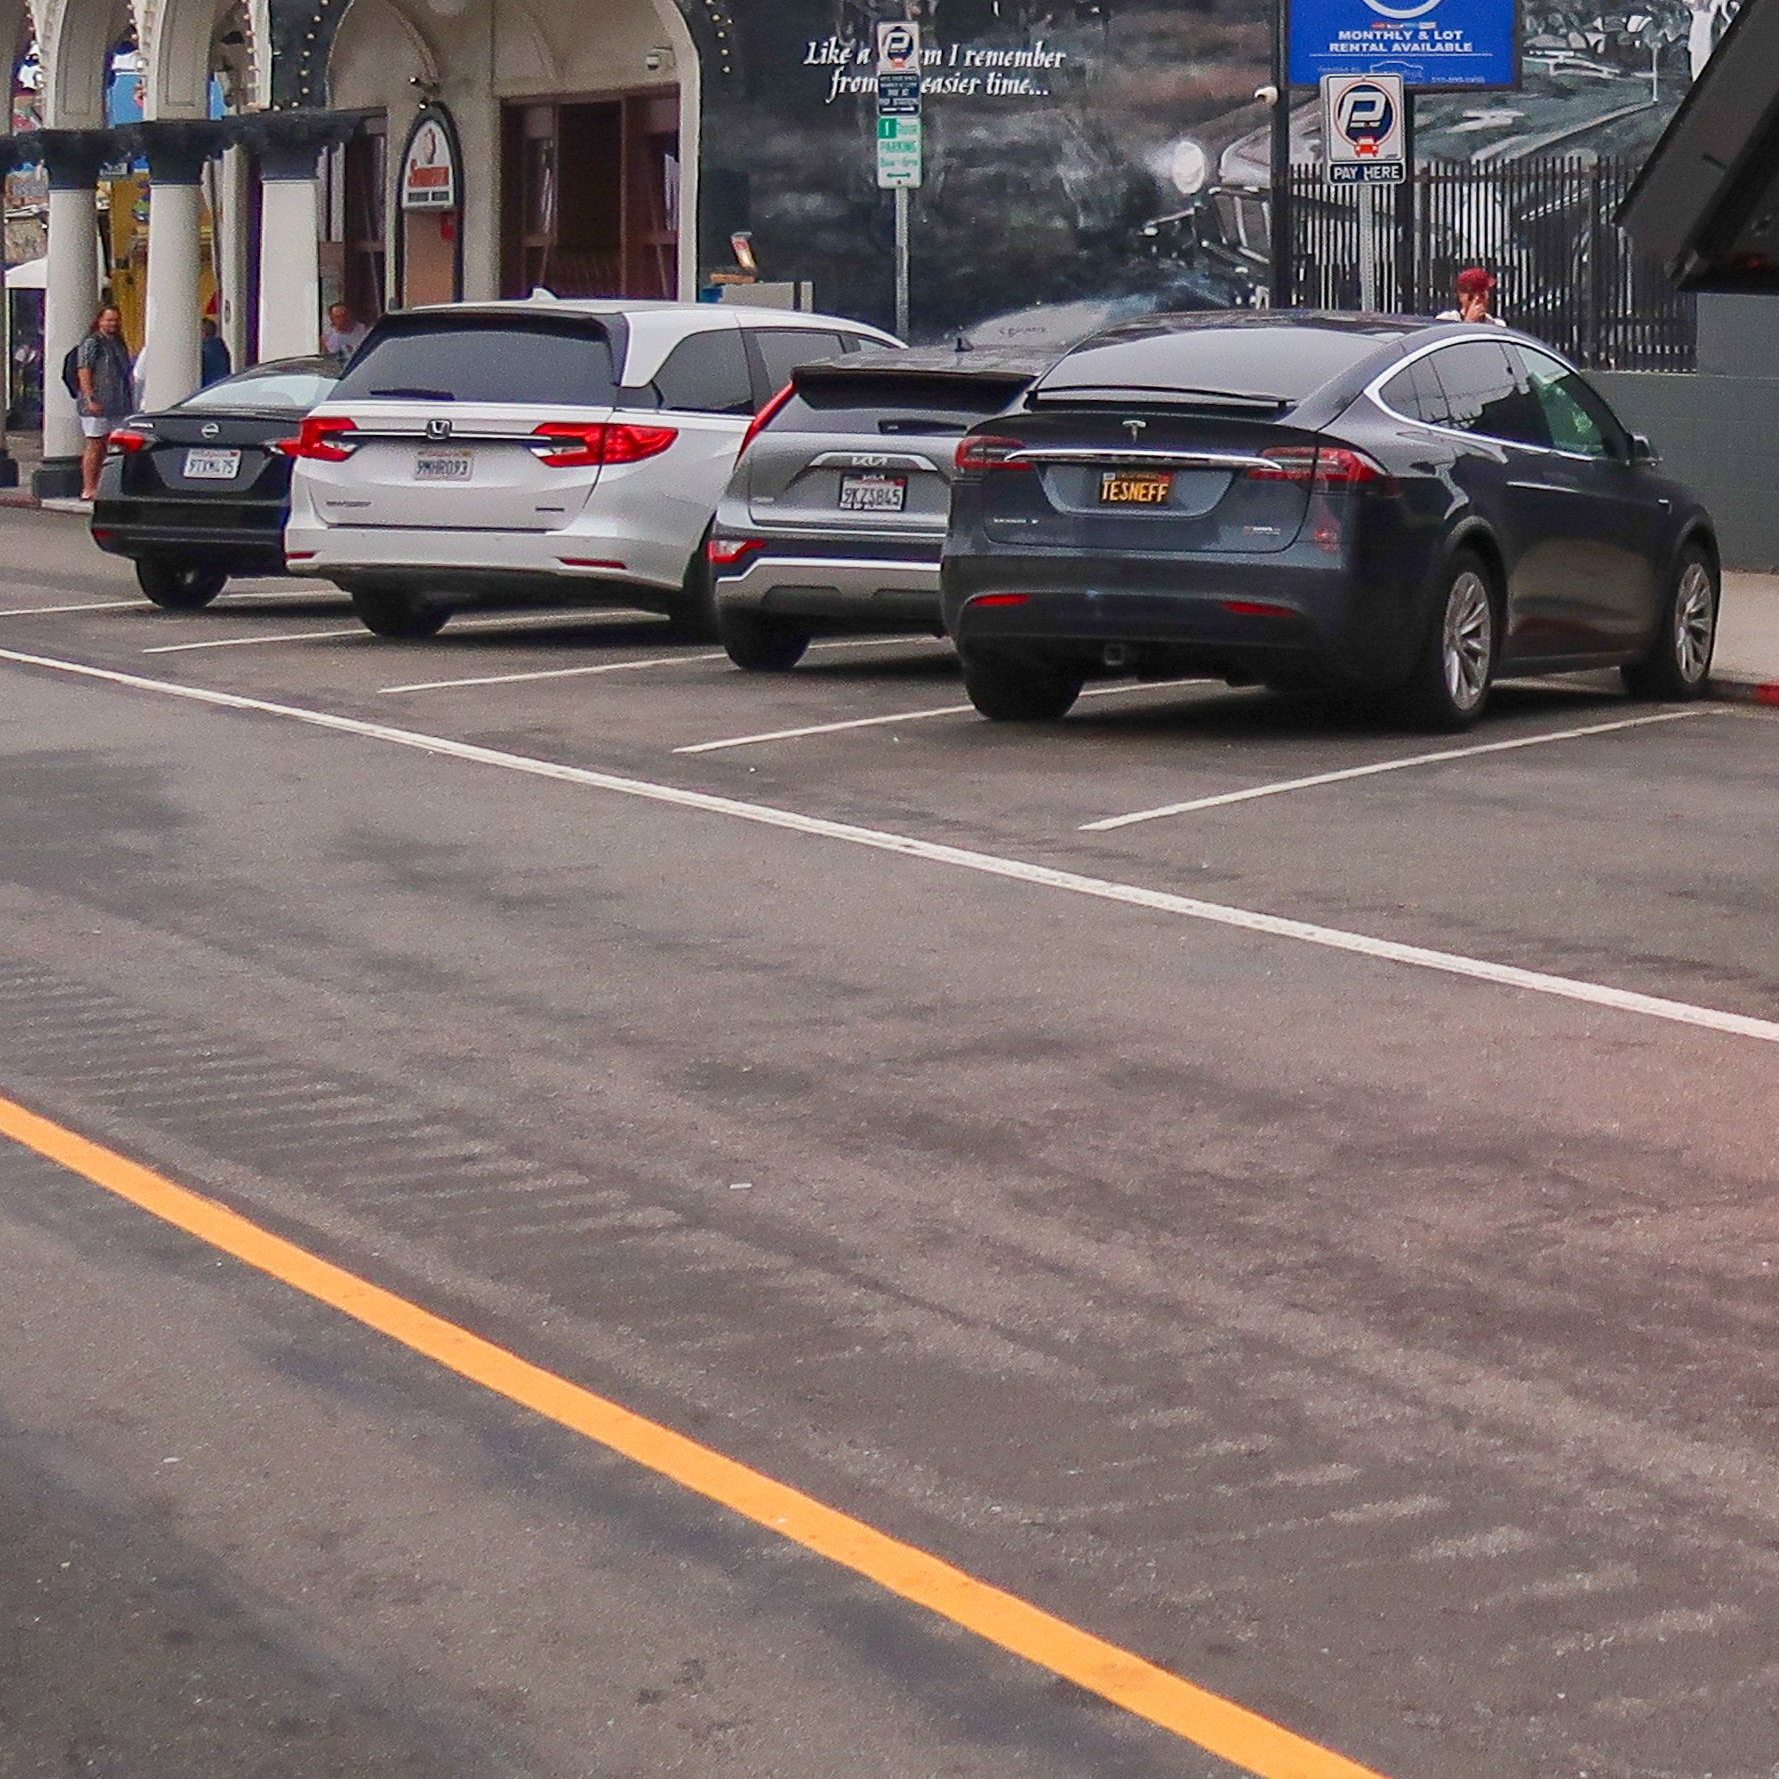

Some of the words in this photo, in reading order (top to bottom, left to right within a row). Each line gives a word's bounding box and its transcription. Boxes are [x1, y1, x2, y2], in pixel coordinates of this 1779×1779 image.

[1338, 31, 1412, 40] MONTHLY
[1418, 31, 1429, 40] &
[1434, 31, 1463, 40] LOT
[804, 36, 852, 65] Like
[856, 49, 872, 65] a
[949, 44, 961, 67] I
[964, 41, 1067, 69] remember
[1329, 43, 1387, 52] RENTAL
[1391, 43, 1473, 52] AVAILABLE
[825, 66, 878, 104] from
[919, 72, 981, 96] easier
[1334, 166, 1358, 180] PAY
[1363, 166, 1399, 181] HERE
